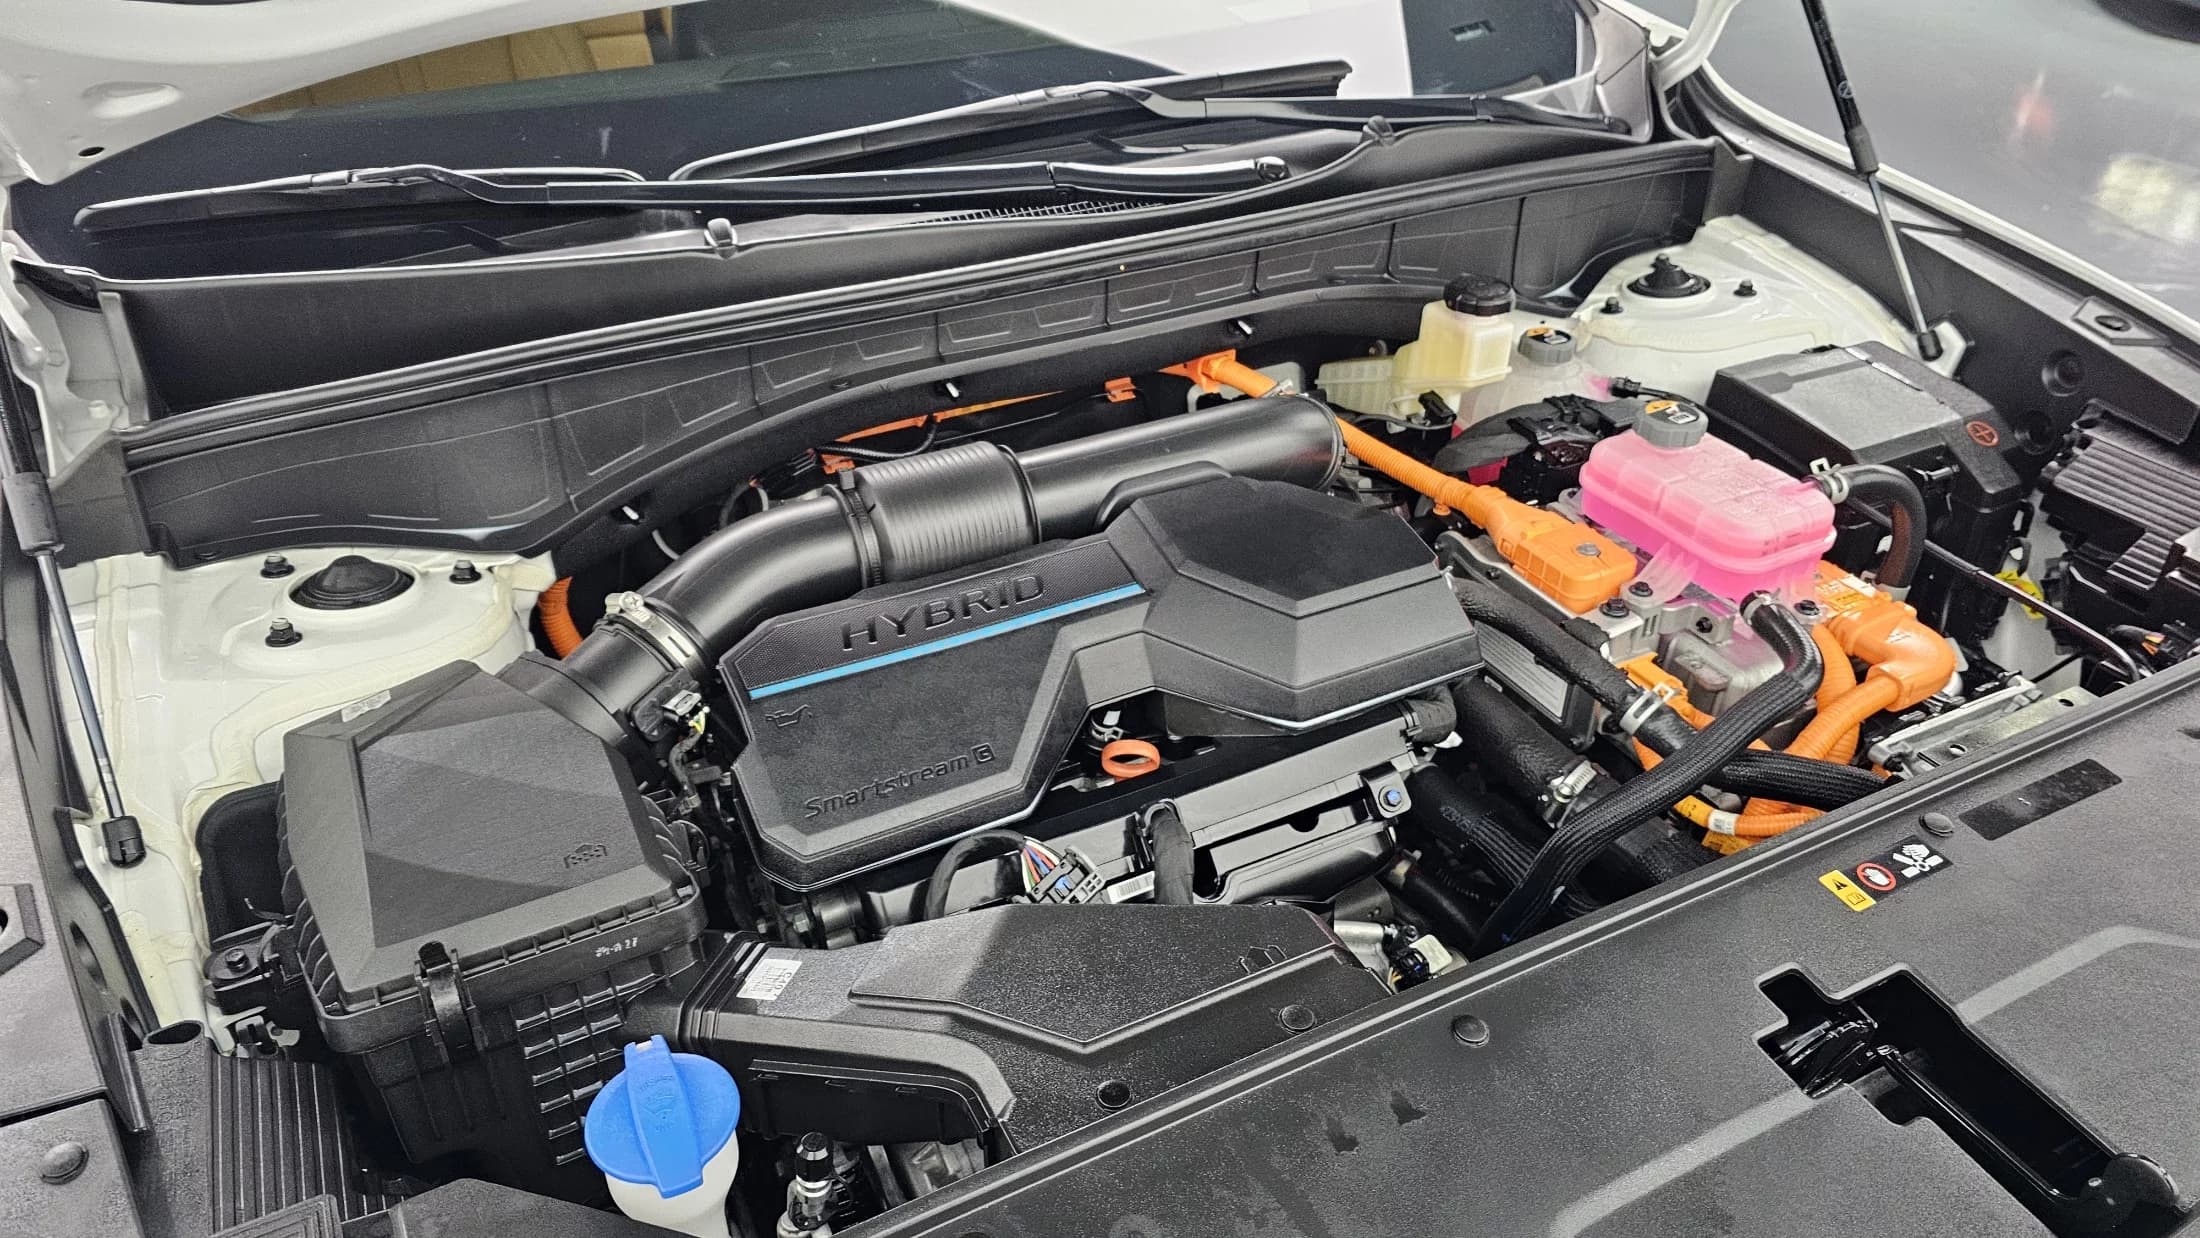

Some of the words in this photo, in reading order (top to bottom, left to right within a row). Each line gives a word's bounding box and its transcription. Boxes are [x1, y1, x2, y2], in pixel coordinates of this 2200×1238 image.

[841, 575, 1044, 651] HYBRID
[804, 754, 968, 818] Smartstream
[972, 743, 996, 764] G
